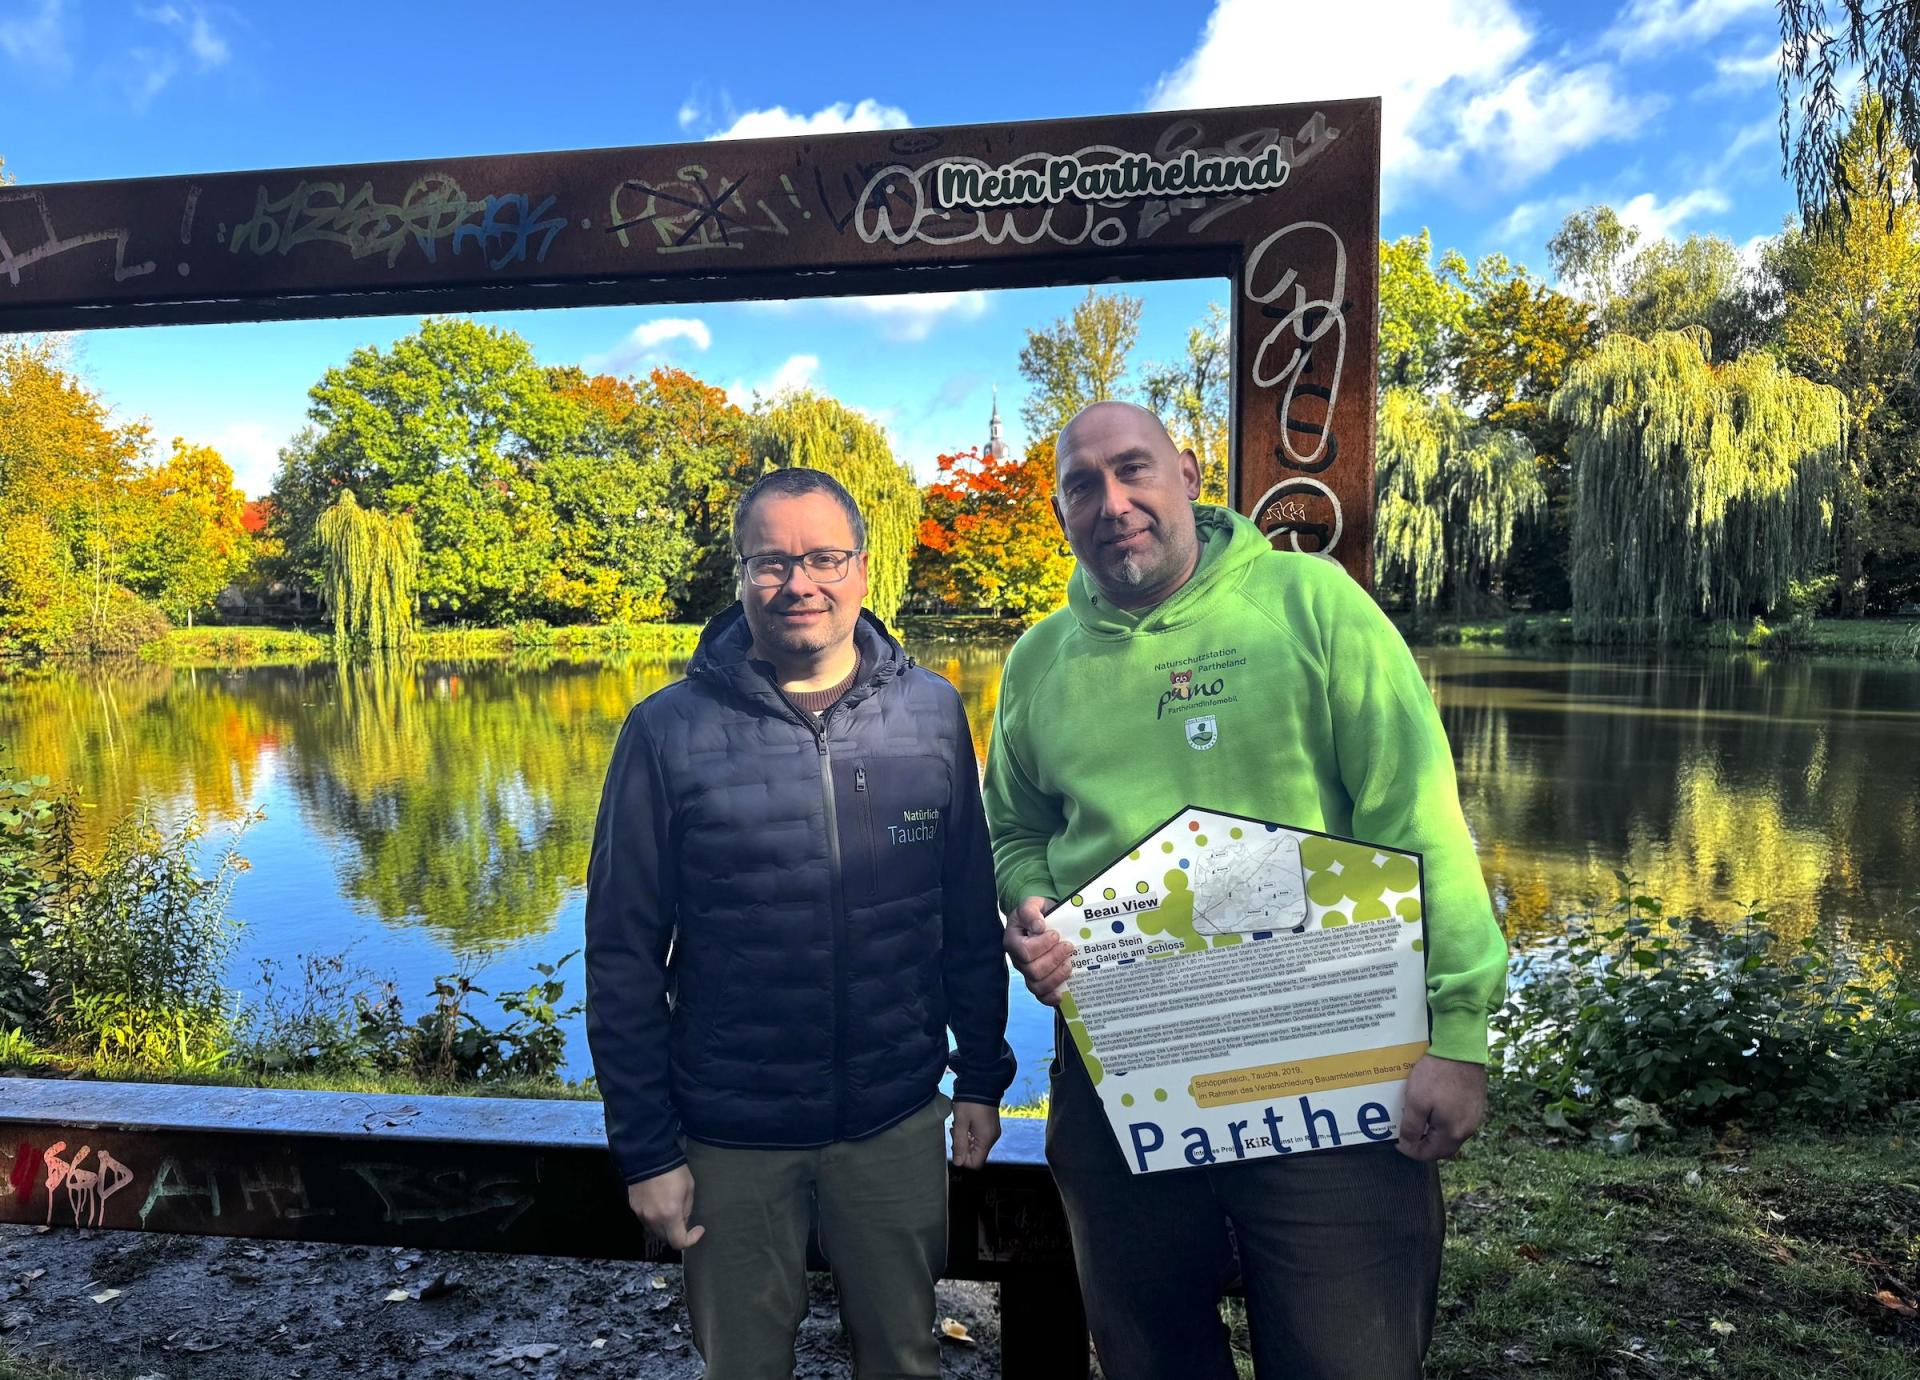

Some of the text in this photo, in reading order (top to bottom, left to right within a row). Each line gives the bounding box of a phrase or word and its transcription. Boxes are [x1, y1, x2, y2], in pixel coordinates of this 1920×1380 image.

[1154, 648, 1237, 671] Naturschutzstation
[1198, 657, 1246, 672] Partheland
[904, 808, 939, 822] Natürlich
[1084, 898, 1158, 920] Beau View
[1084, 942, 1116, 954] Babara
[1118, 937, 1142, 948] Stein
[1096, 951, 1128, 963] Galerie
[1147, 940, 1184, 954] Schloss
[1208, 1090, 1239, 1098] Rahmen
[1254, 1078, 1314, 1092] Verabschiedung
[1314, 1068, 1372, 1083] Bauamtsleiterin
[1129, 1096, 1393, 1172] Parthe
[1244, 1136, 1272, 1150] KiR
